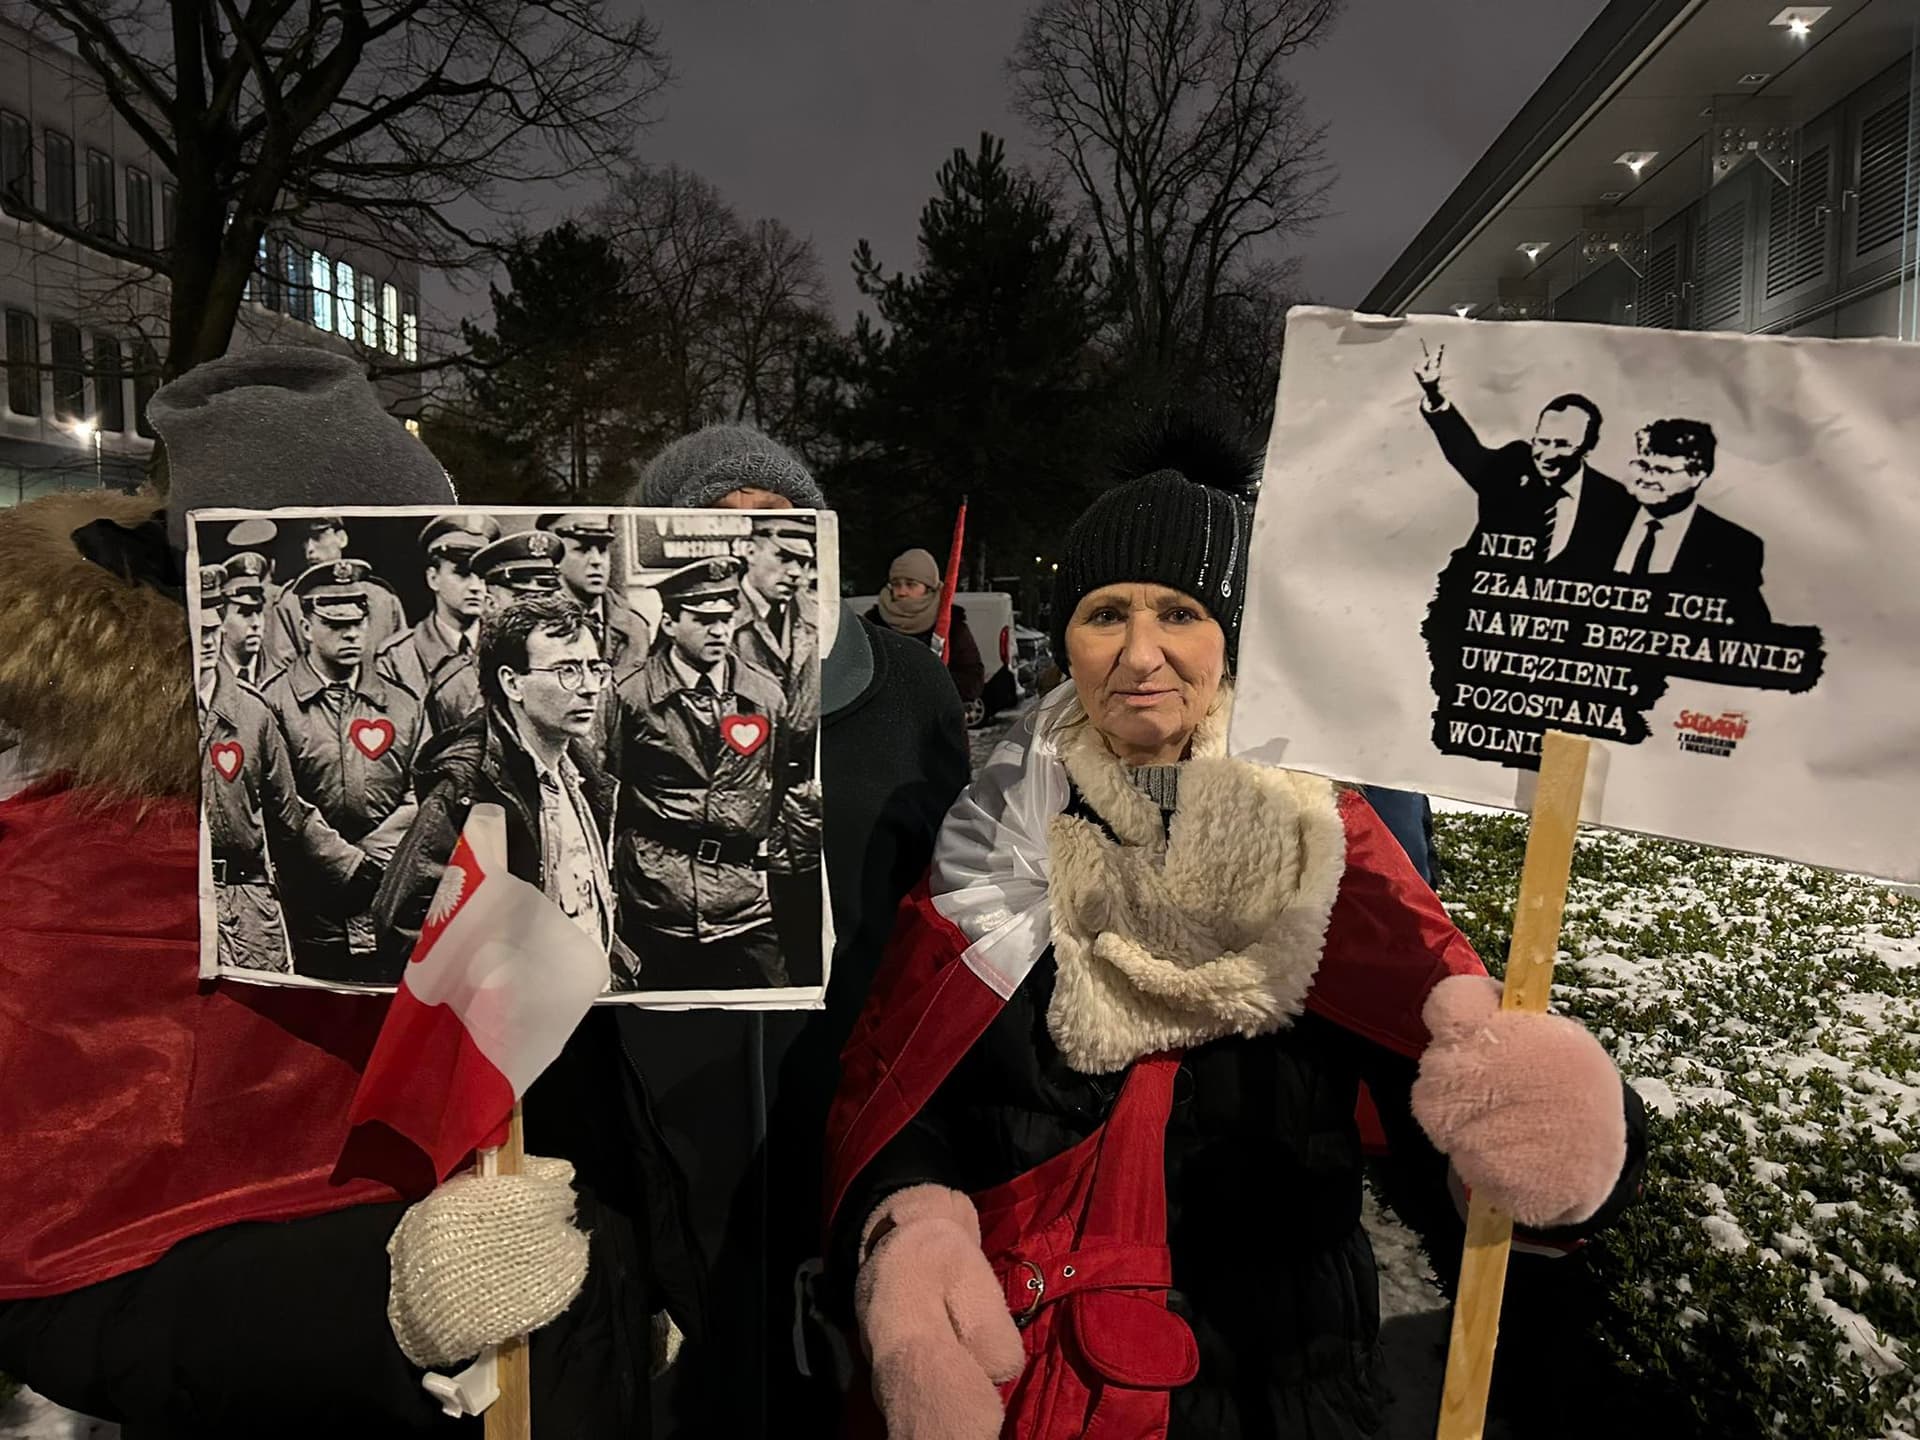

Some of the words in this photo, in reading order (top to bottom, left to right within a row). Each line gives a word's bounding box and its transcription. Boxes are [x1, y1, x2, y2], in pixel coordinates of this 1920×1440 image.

[1478, 532, 1537, 560] NIE
[1471, 570, 1652, 614] ZŁAMIECIE
[1664, 592, 1735, 626] ICH.
[1465, 608, 1570, 644] NAWET
[1581, 623, 1806, 674] BEZPRAWNIE
[1461, 646, 1640, 697] UWIĘZIENI,
[1452, 683, 1628, 737] POZOSTANĄ
[1448, 719, 1541, 756] WOLNI
